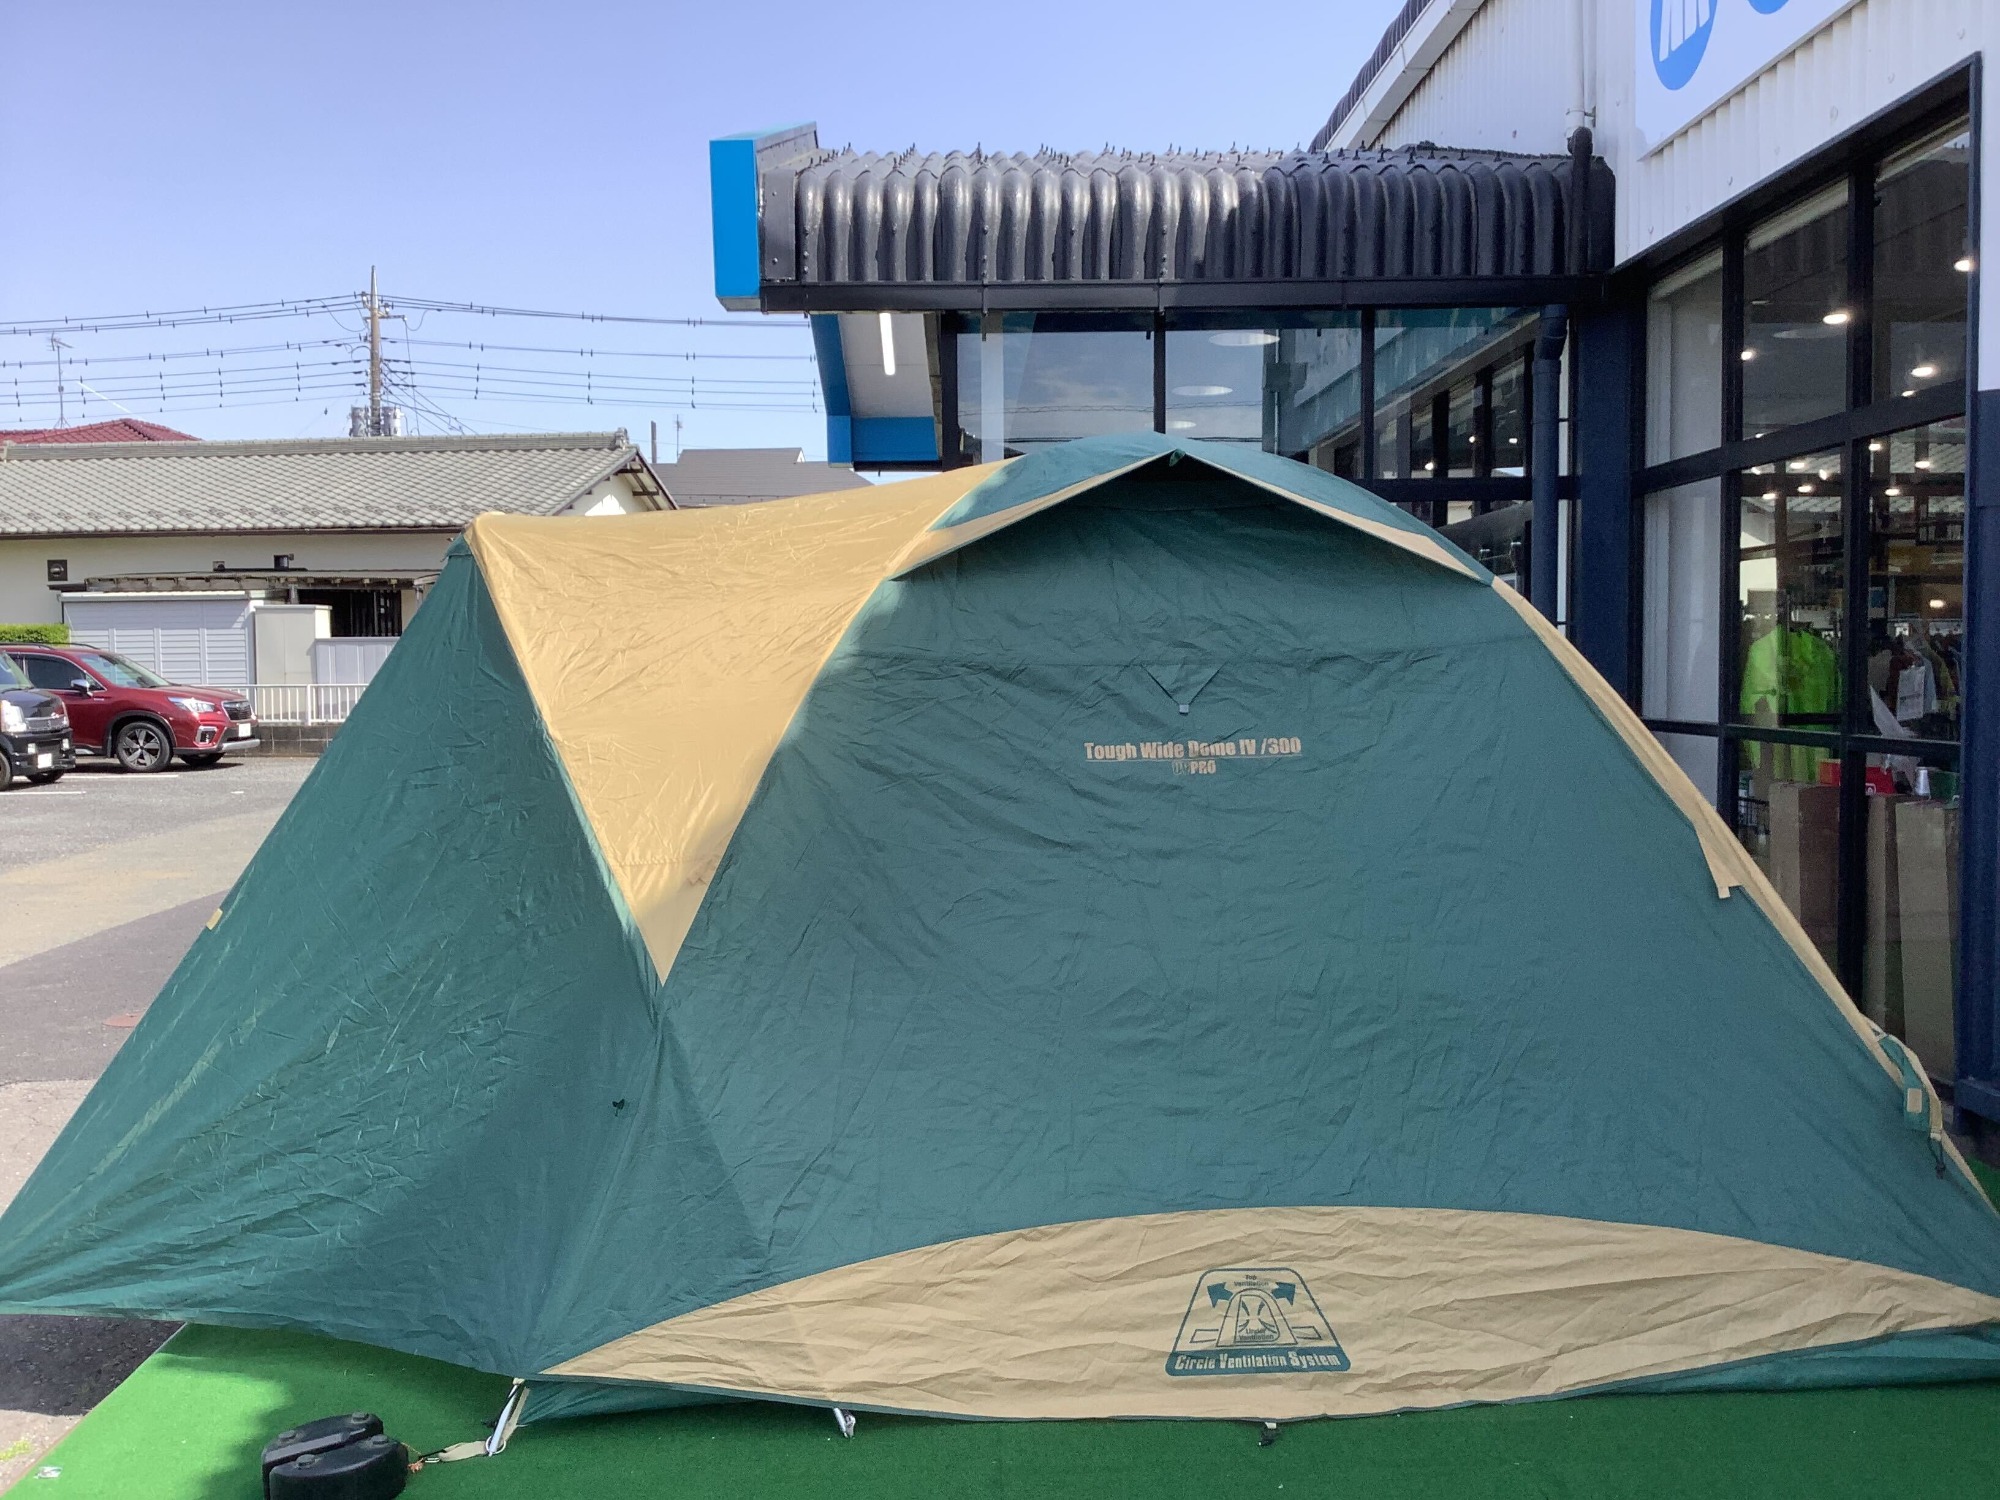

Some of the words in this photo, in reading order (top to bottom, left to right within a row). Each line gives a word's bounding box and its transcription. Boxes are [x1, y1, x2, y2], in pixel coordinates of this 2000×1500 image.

[1084, 742, 1137, 761] Tough
[1140, 741, 1184, 759] Wide
[1187, 740, 1236, 758] Dome
[1174, 1354, 1216, 1370] Circle
[1219, 1353, 1287, 1369] Ventilation
[1287, 1350, 1341, 1369] System
